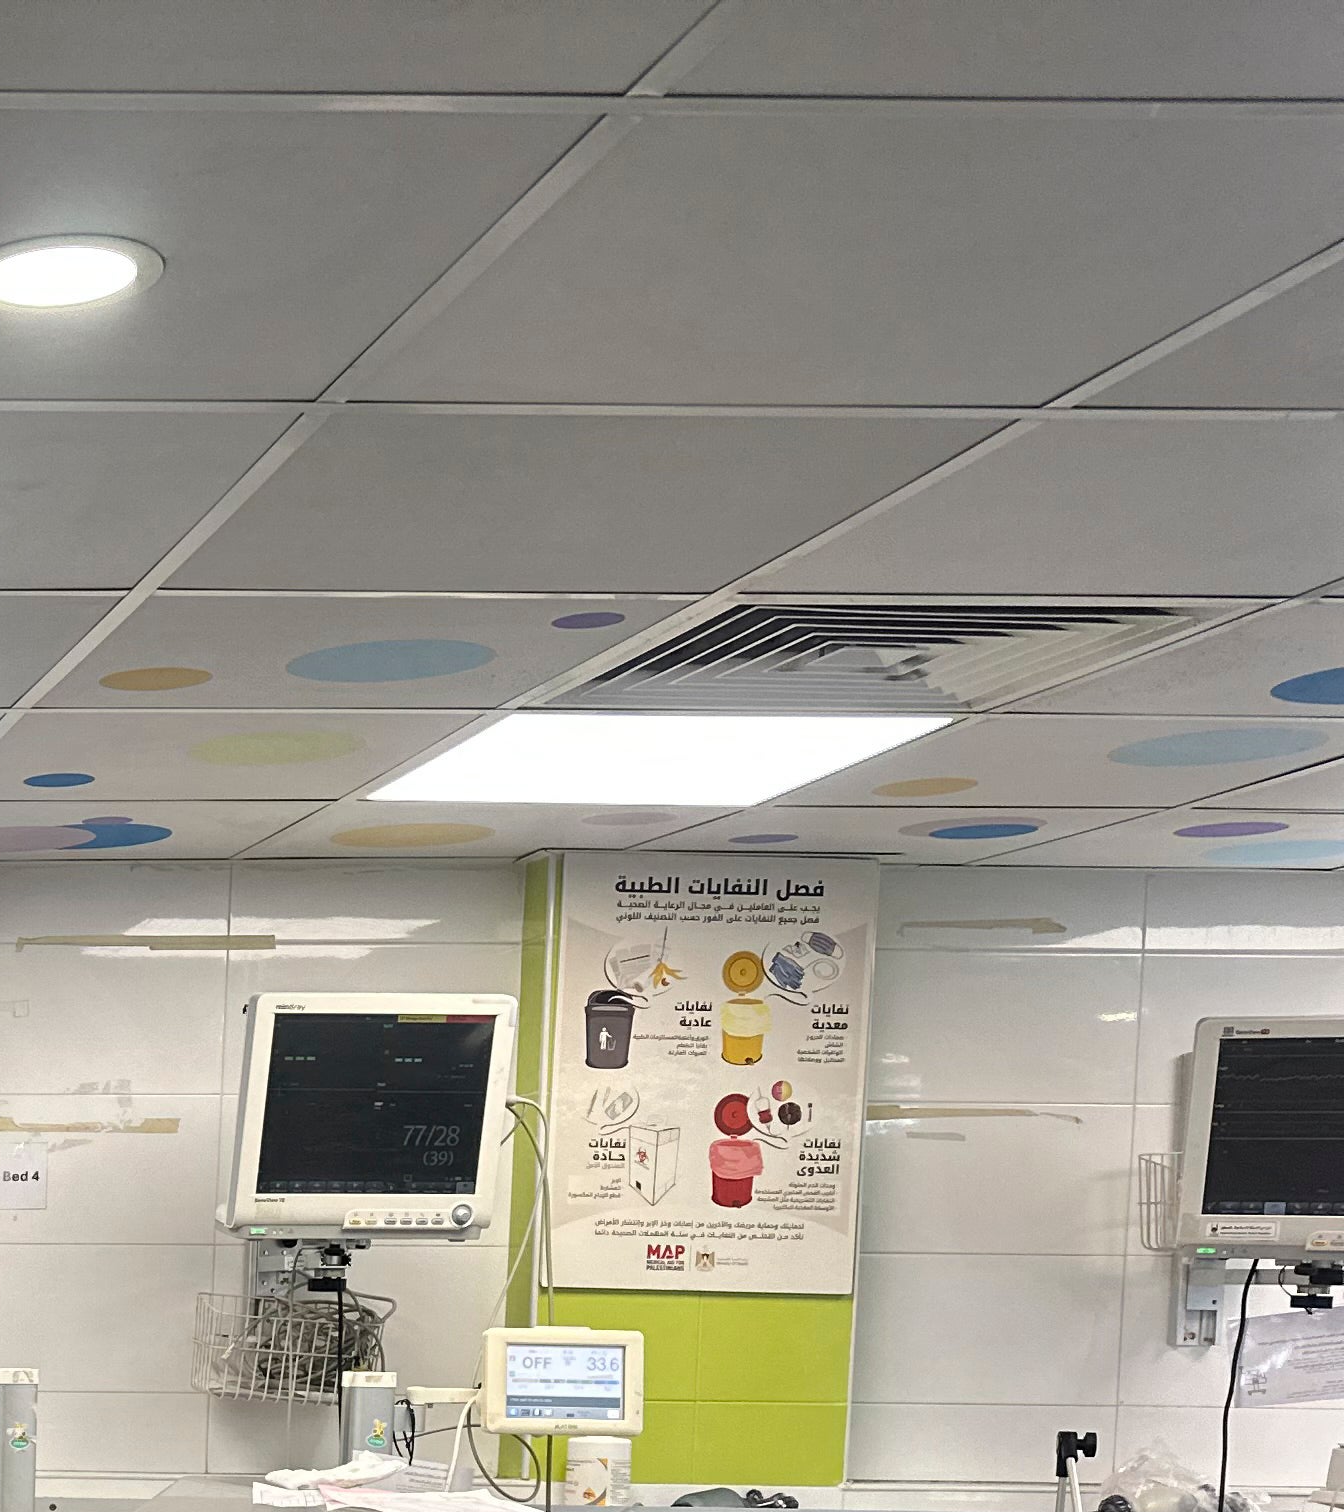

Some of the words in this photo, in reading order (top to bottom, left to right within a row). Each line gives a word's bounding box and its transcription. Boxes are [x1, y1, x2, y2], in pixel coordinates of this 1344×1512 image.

[615, 875, 679, 899] الطبية
[689, 878, 767, 900] النفايات
[777, 879, 824, 900] فصل
[617, 900, 650, 910] الصحية
[654, 901, 685, 910] الرعاية
[688, 902, 711, 910] مجال
[714, 904, 734, 912] في
[737, 903, 774, 912] العاملين
[778, 904, 797, 912] على
[800, 905, 820, 914] يجب
[616, 912, 641, 923] اللوني
[644, 912, 676, 922] التصنيف
[702, 914, 723, 923] الفور
[726, 914, 742, 923] على
[745, 914, 776, 924] النفايات
[778, 916, 797, 925] جميع
[800, 916, 819, 925] فصل
[674, 1000, 712, 1014] نفايات
[811, 1004, 848, 1017] نفايات
[680, 1016, 711, 1030] عادية
[812, 1019, 848, 1032] معدية
[403, 1125, 460, 1146] 77/28
[589, 1138, 626, 1151] نفايات
[804, 1138, 841, 1151] نفايات
[423, 1151, 454, 1166] (39)
[593, 1150, 625, 1161] حادة
[799, 1150, 840, 1164] شديدة
[797, 1164, 839, 1176] العدوى
[3, 1171, 28, 1181] Bed
[32, 1171, 39, 1181] 4
[647, 1244, 685, 1259] MAP
[523, 1357, 552, 1369] OFF
[587, 1357, 620, 1372] 33.6
